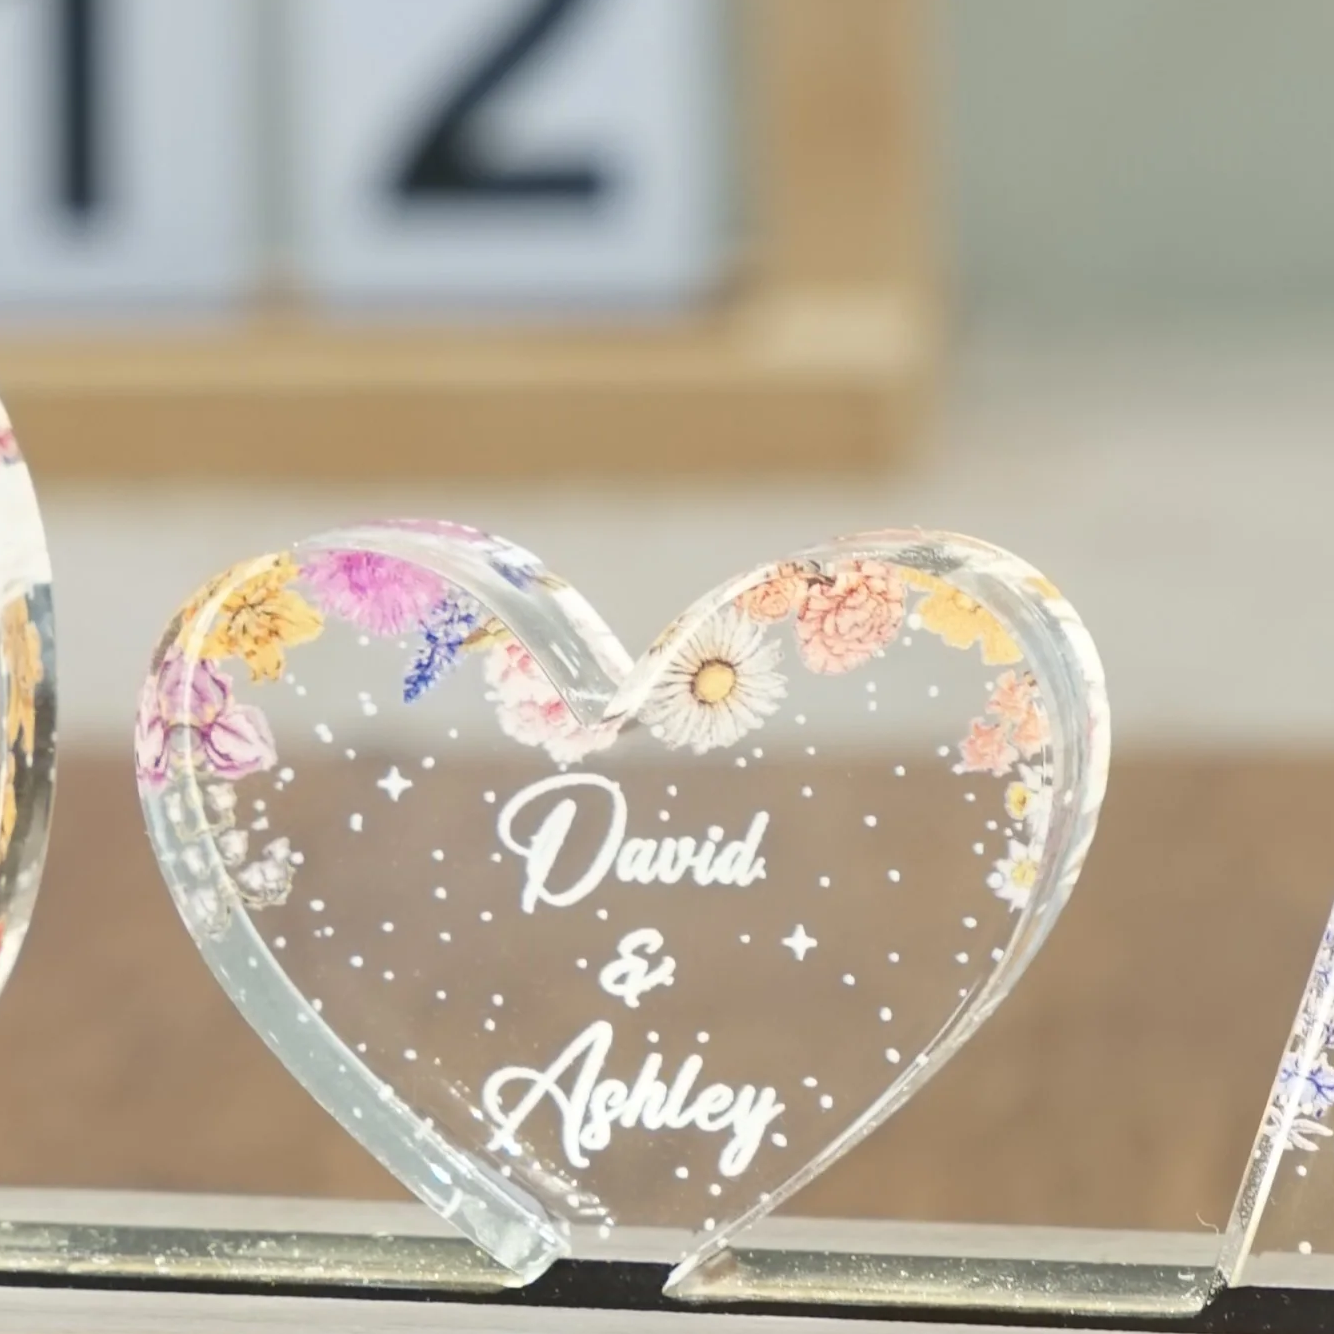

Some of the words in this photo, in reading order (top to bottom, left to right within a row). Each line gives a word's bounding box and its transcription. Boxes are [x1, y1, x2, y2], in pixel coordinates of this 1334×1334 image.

[496, 772, 771, 915] David
[598, 927, 677, 1009] &
[482, 1019, 787, 1178] Ashley
